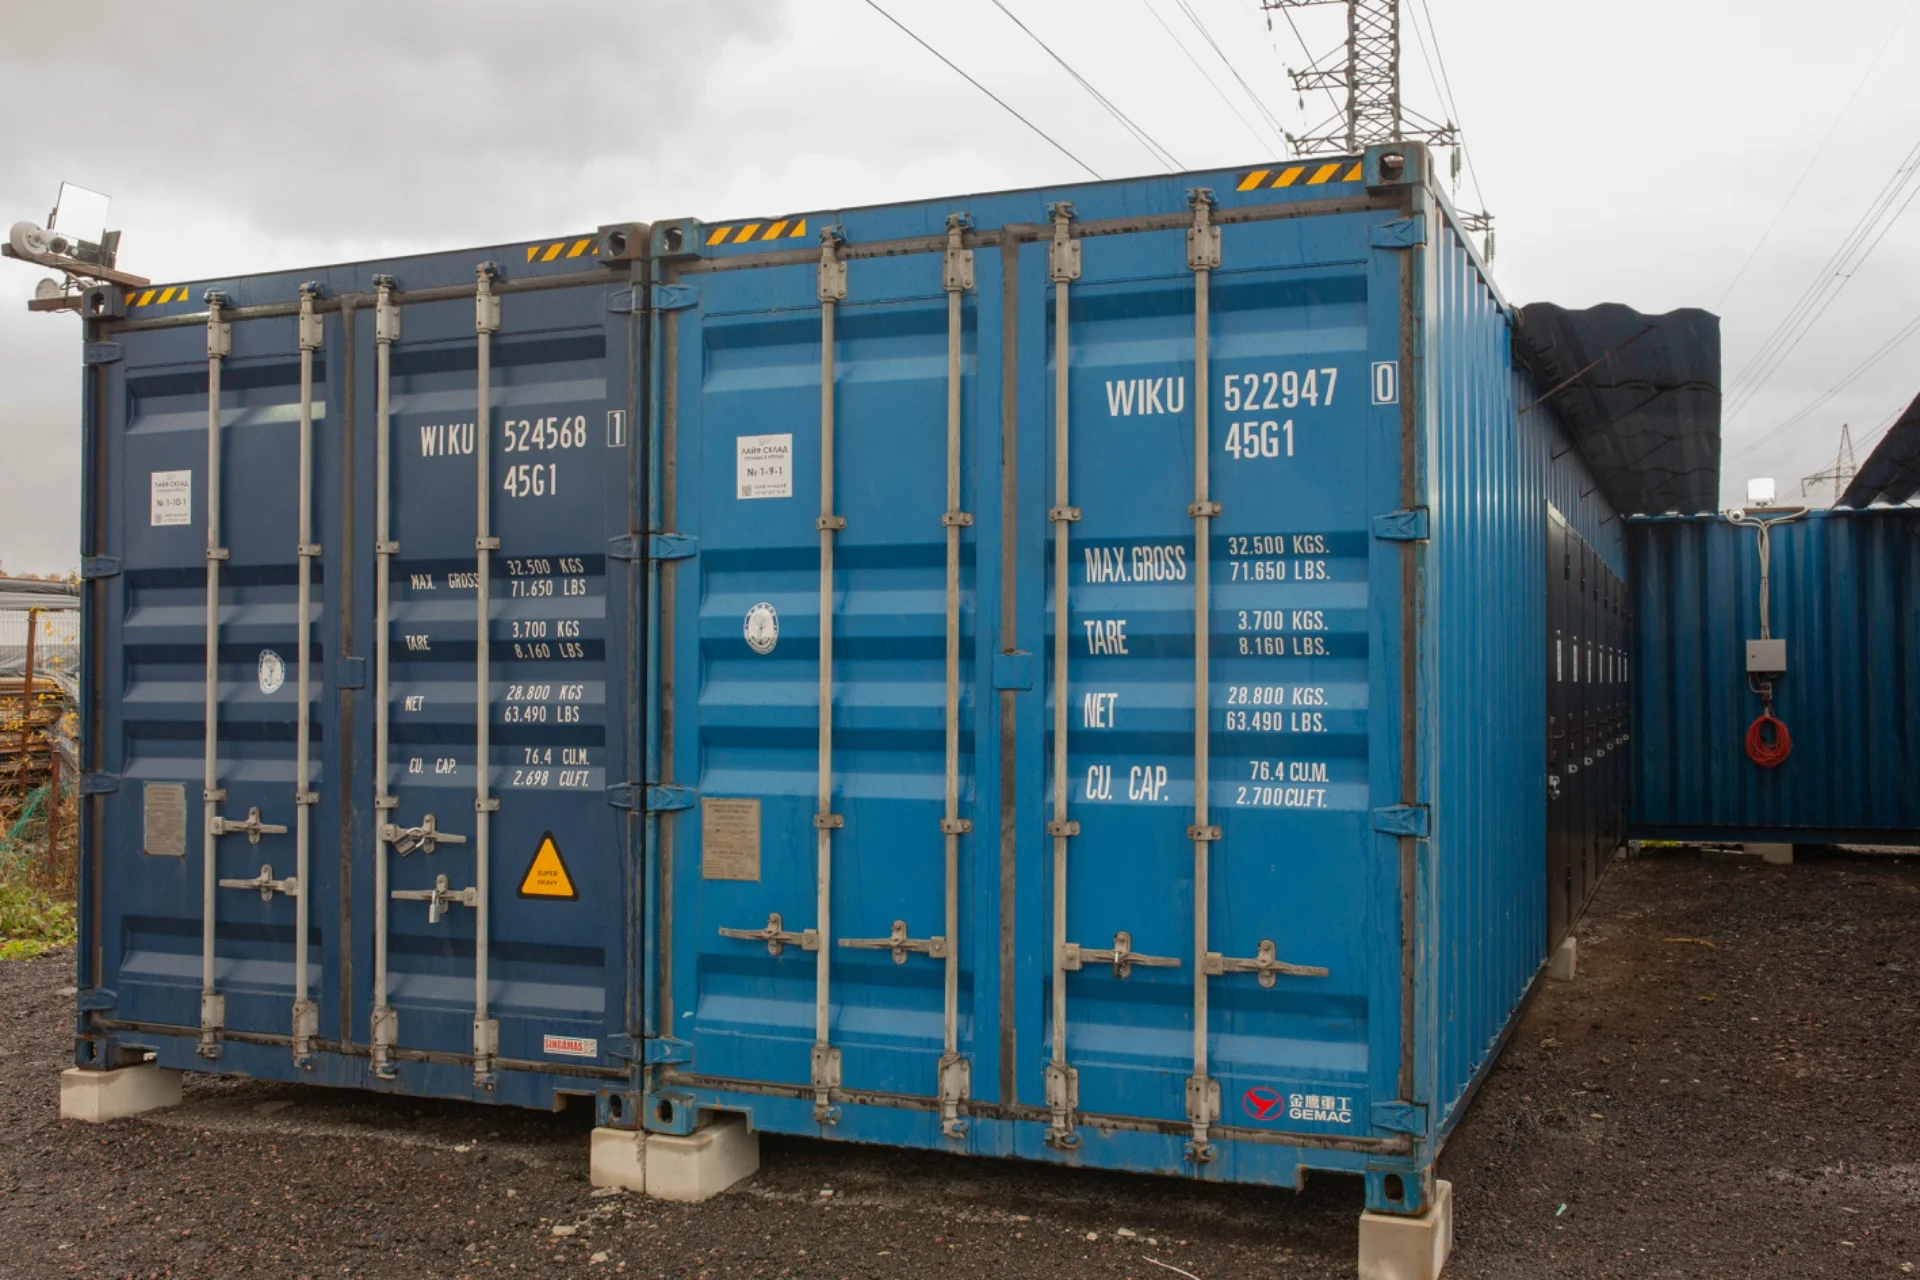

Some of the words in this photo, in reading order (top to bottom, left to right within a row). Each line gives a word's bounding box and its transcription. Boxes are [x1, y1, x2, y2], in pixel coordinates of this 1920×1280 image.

[1105, 377, 1185, 417] WIKU
[1224, 367, 1338, 412] 522947
[1376, 364, 1394, 402] 0
[420, 423, 475, 457] WIKU
[504, 415, 587, 452] 524568
[1225, 419, 1295, 460] 45G1
[760, 466, 782, 476] 1-9-1
[503, 463, 557, 498] 45G1
[1228, 536, 1285, 555] 32.500
[1293, 535, 1330, 554] KGS.
[507, 559, 551, 576] 32.500
[559, 558, 584, 574] KGS
[1230, 561, 1286, 581] 71.650
[1295, 560, 1331, 580] LBS.
[410, 574, 437, 590] MAX.
[447, 573, 479, 589] GROSS
[511, 580, 553, 597] 71.650
[563, 579, 586, 596] LBS
[557, 621, 579, 637] KGS
[1238, 611, 1283, 631] 3.700
[1292, 611, 1329, 631] KGS.
[405, 635, 431, 651] TARE
[1084, 620, 1129, 655] TARE
[1239, 637, 1285, 655] 8.160
[1293, 637, 1330, 656] LBS.
[515, 643, 551, 659] 8.160
[559, 643, 584, 658] LBS
[506, 685, 550, 701] 28.800
[559, 685, 583, 700] KGS
[1227, 686, 1284, 705] 28.800
[1292, 687, 1329, 706] KGS.
[405, 695, 424, 711] NET
[1084, 693, 1118, 728] NET
[504, 706, 547, 722] 63.490
[557, 706, 579, 722] LBS
[1226, 711, 1283, 731] 63.490
[1291, 712, 1328, 732] LBS.
[525, 748, 552, 765] 76.4
[409, 758, 424, 774] CU.
[435, 758, 457, 774] CAP.
[1250, 761, 1285, 781] 76.4
[512, 770, 549, 786] 2.698
[1086, 765, 1113, 800] CU.
[1128, 765, 1169, 801] CAP.
[1289, 1108, 1351, 1123] GEMAC
